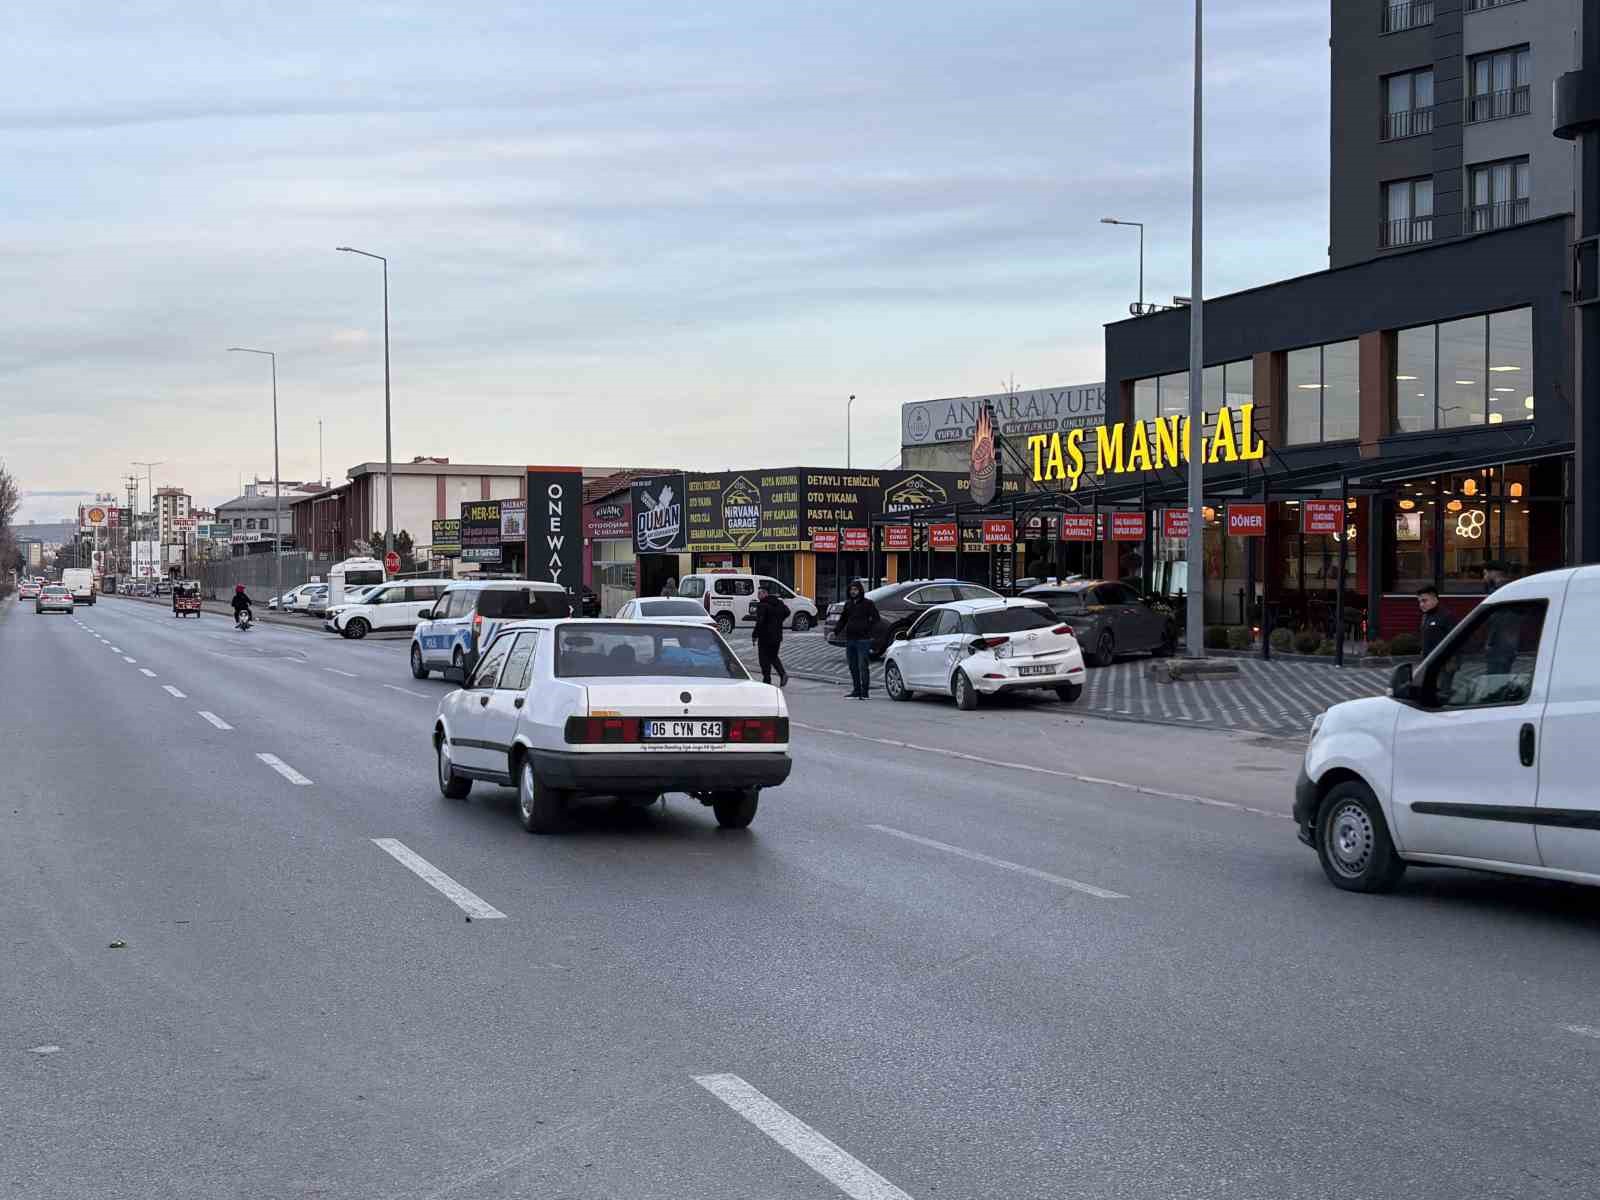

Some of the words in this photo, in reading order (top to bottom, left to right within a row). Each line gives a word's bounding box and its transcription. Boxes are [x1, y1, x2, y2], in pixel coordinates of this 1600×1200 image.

[944, 394, 1041, 424] ANARA
[1028, 428, 1085, 492] TAŞ
[807, 475, 840, 487] DETAYLI
[842, 474, 880, 488] TEMİZLİK
[807, 492, 824, 503] OTO
[826, 493, 858, 503] YIKAMA
[637, 504, 680, 532] DUMAN
[807, 509, 833, 520] PASTA
[835, 507, 854, 520] CİLA
[728, 518, 757, 528] GARAGE
[1231, 514, 1262, 527] DÖNER
[991, 523, 1006, 532] KİLO
[985, 533, 1011, 541] MANGAL
[652, 722, 666, 736] 06
[673, 722, 694, 736] CYN
[701, 722, 721, 736] 643
